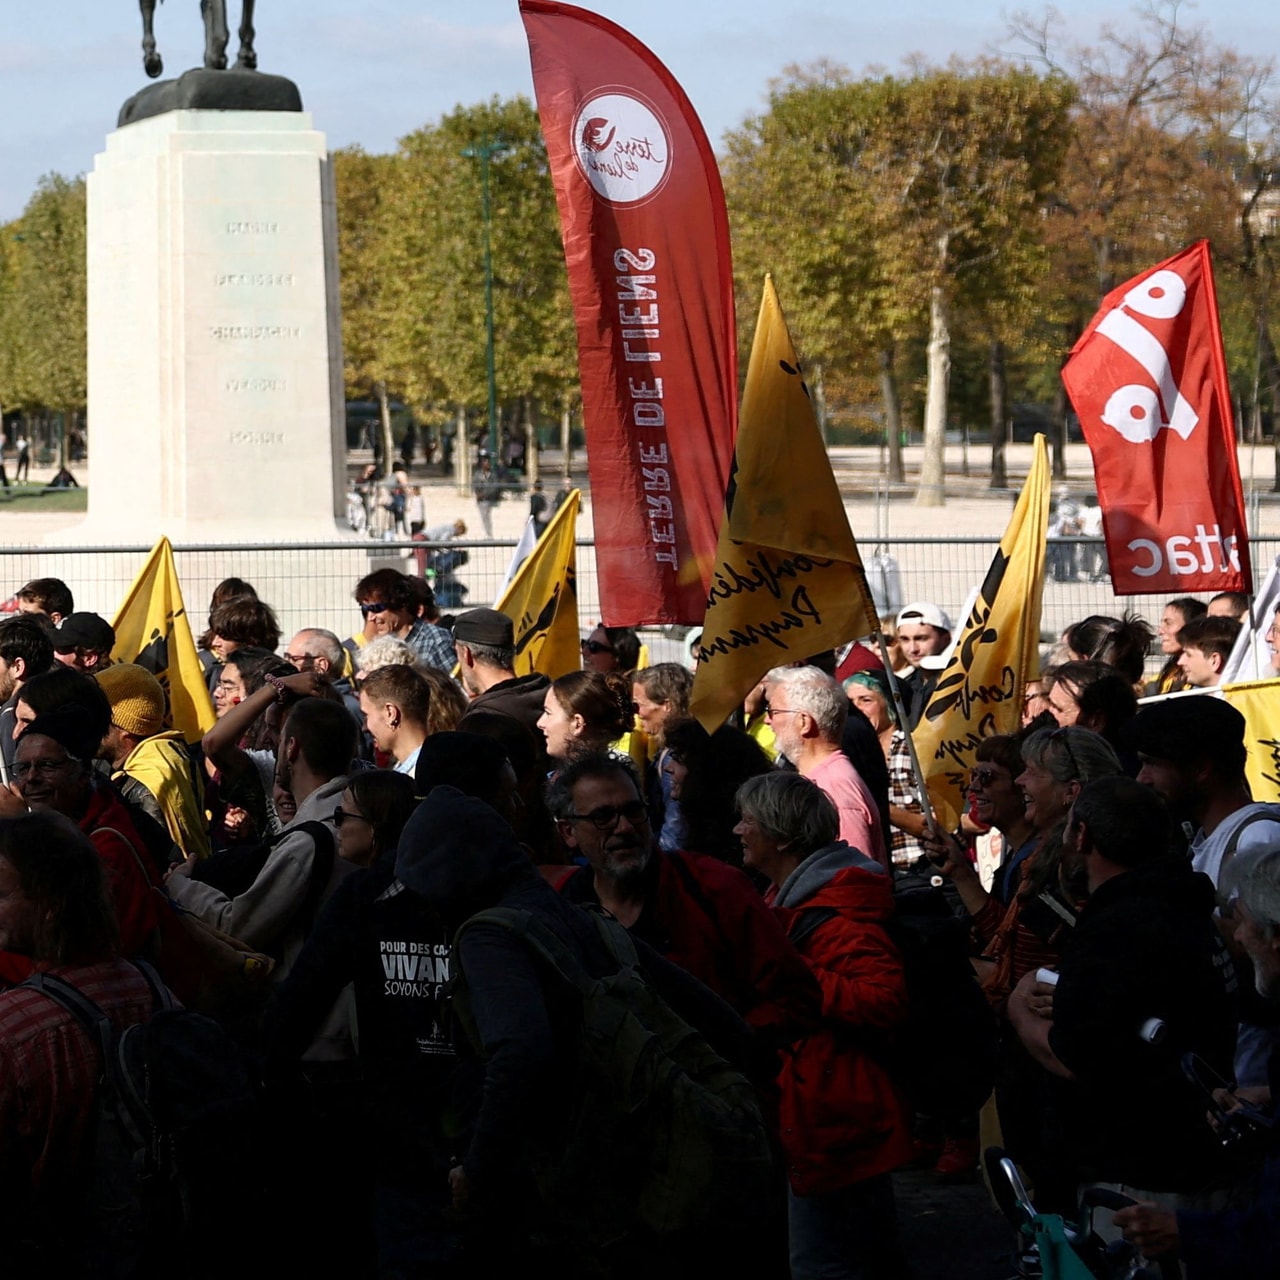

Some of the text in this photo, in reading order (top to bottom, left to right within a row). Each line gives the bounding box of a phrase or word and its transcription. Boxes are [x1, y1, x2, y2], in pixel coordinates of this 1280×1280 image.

[380, 940, 406, 953] POUR
[409, 942, 430, 955] DES
[384, 979, 430, 998] SOYONS
